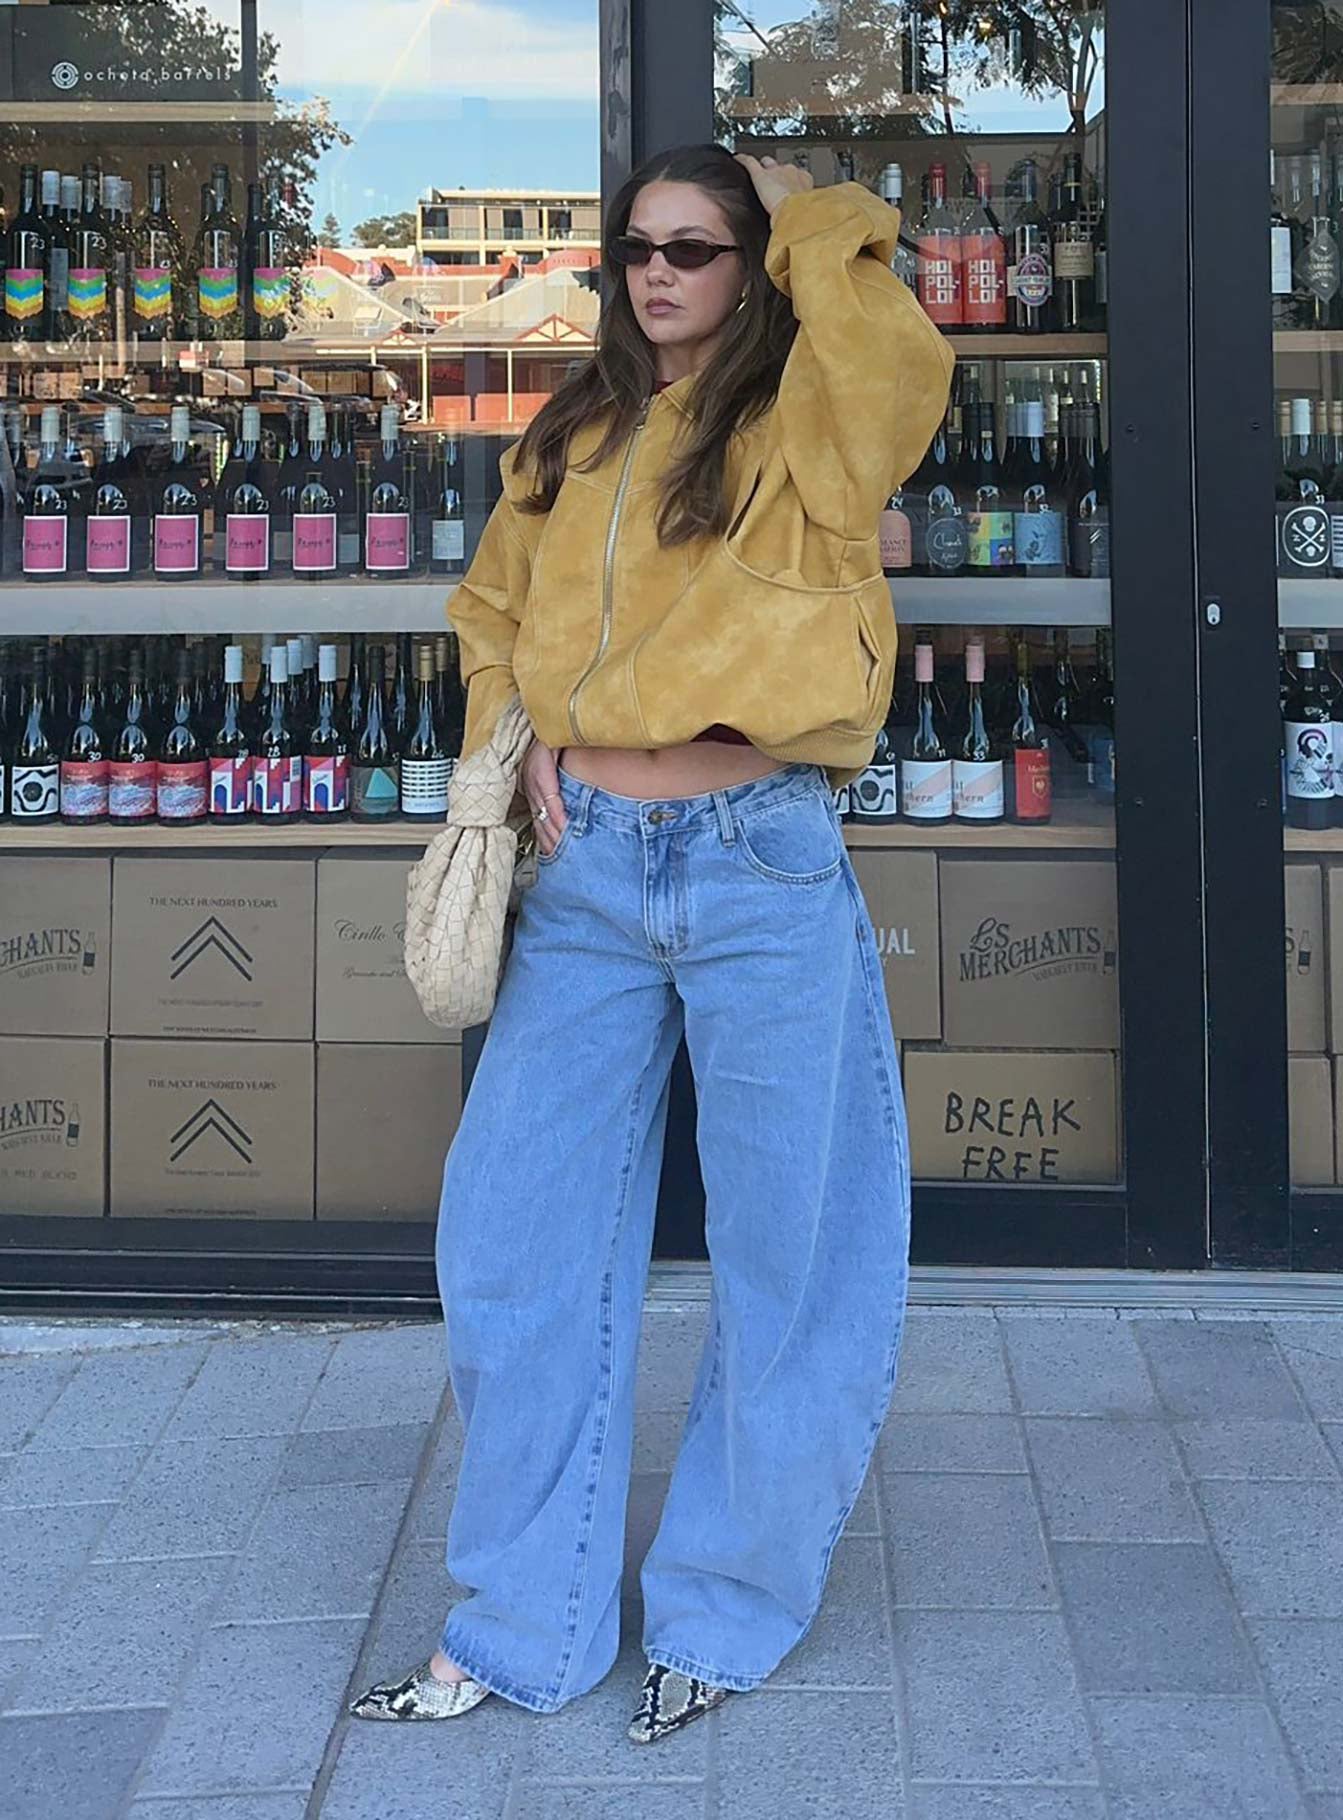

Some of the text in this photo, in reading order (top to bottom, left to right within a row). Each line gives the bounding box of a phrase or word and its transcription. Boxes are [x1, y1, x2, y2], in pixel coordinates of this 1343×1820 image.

[161, 67, 231, 82] barrels
[30, 236, 45, 249] 23
[91, 236, 107, 250] 23
[925, 260, 952, 274] HOI
[968, 260, 995, 274] HOI
[926, 290, 953, 304] LOI
[969, 290, 996, 304] LOI
[55, 500, 67, 510] 23
[180, 492, 198, 506] 23
[322, 496, 337, 508] 23
[87, 751, 102, 762] 30
[131, 752, 145, 764] 30
[149, 896, 278, 908] THE NEXT HUNDRED YEARS
[960, 927, 1101, 981] MERCHANTS
[148, 1078, 278, 1090] THE NEXT HUNDRED YEARS
[945, 1091, 1081, 1138] BREAK
